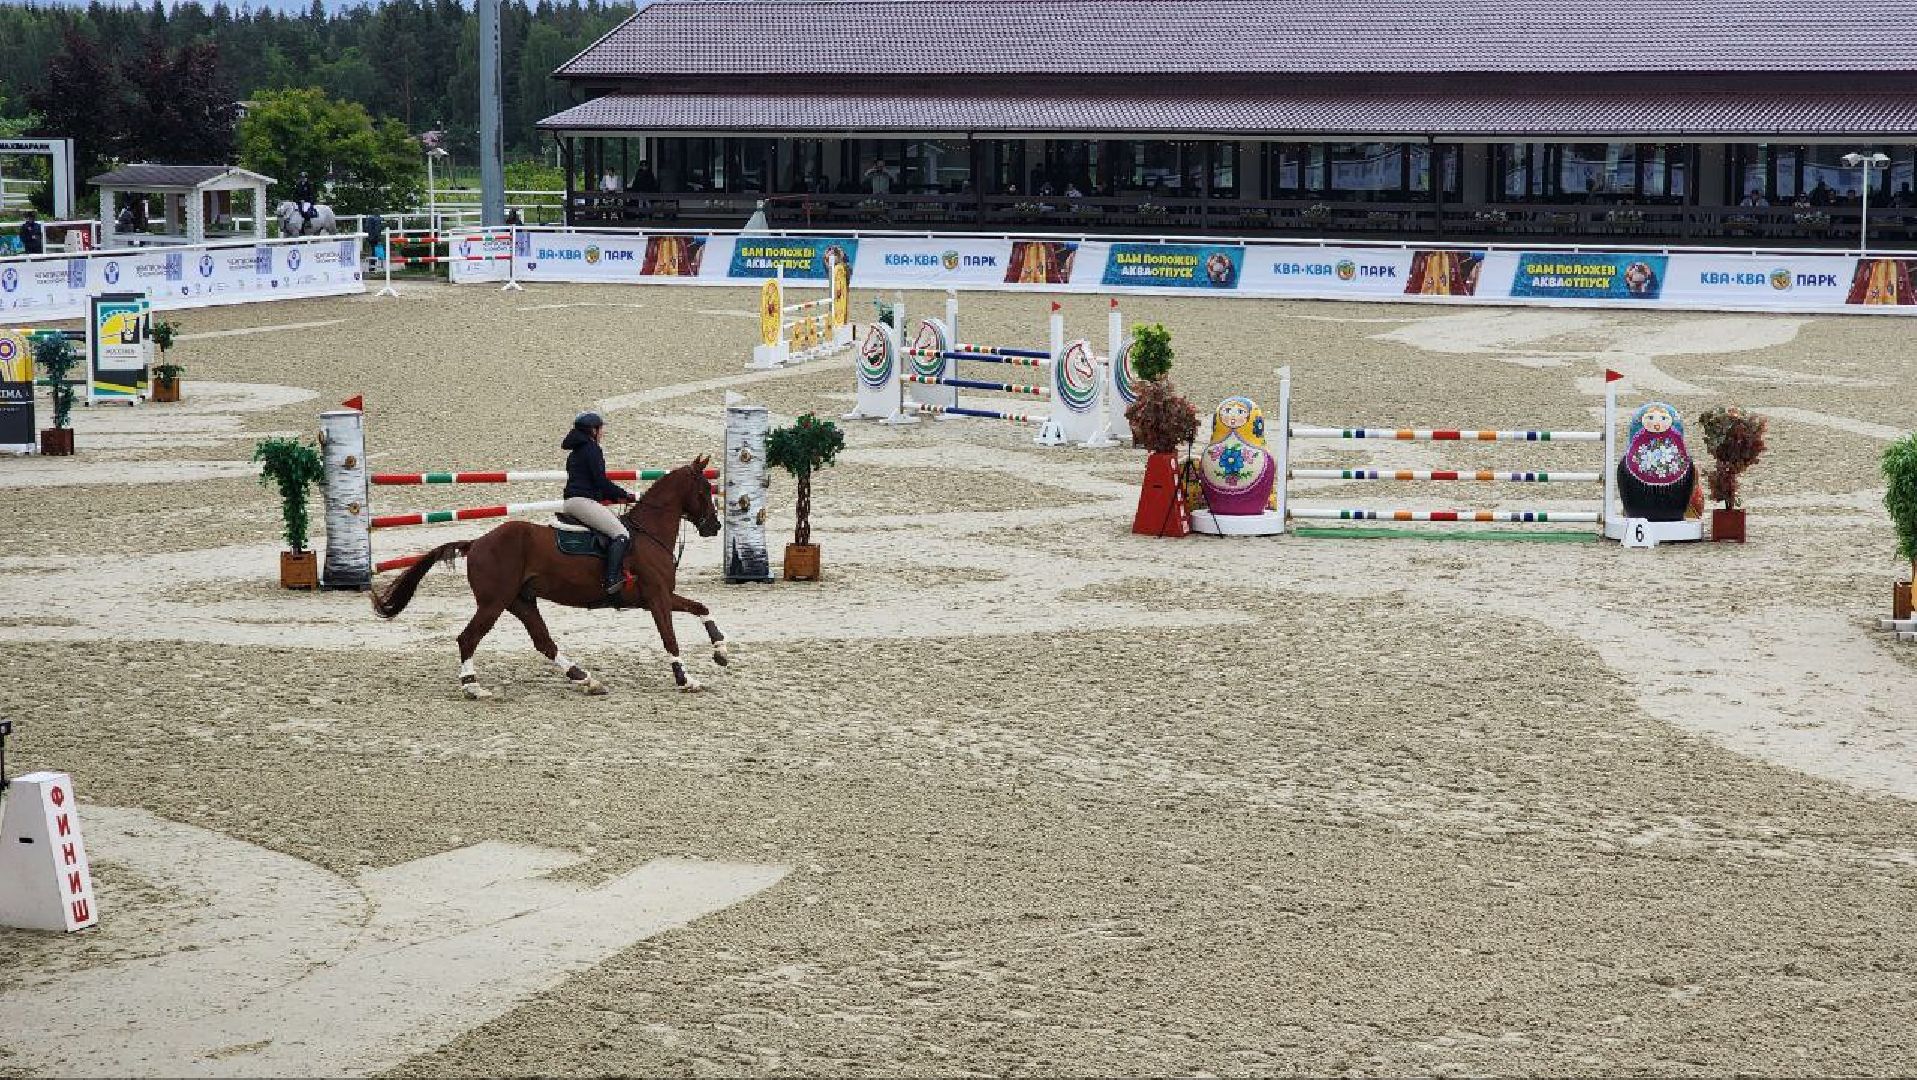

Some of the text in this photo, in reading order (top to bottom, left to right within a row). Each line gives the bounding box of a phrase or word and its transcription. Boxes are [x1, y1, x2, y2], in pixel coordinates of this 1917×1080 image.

[604, 250, 634, 260] ПАРК
[741, 247, 815, 257] ВАМ ПОЛОЖЕН
[746, 258, 811, 269] АКВАОТПУСК
[963, 255, 998, 266] ПАРК
[1116, 253, 1198, 265] ВАМ ПОЛОЖЕН
[1121, 266, 1193, 278] АКВАОТПУСК
[1360, 266, 1396, 277] ПАРК
[1527, 264, 1616, 276] ВАМ ПОЛОЖЕН
[1532, 277, 1610, 288] АКВАОТПУСК
[1796, 274, 1837, 287] ПАРК
[1635, 523, 1645, 543] 6
[51, 786, 90, 923] ФИНИШ
